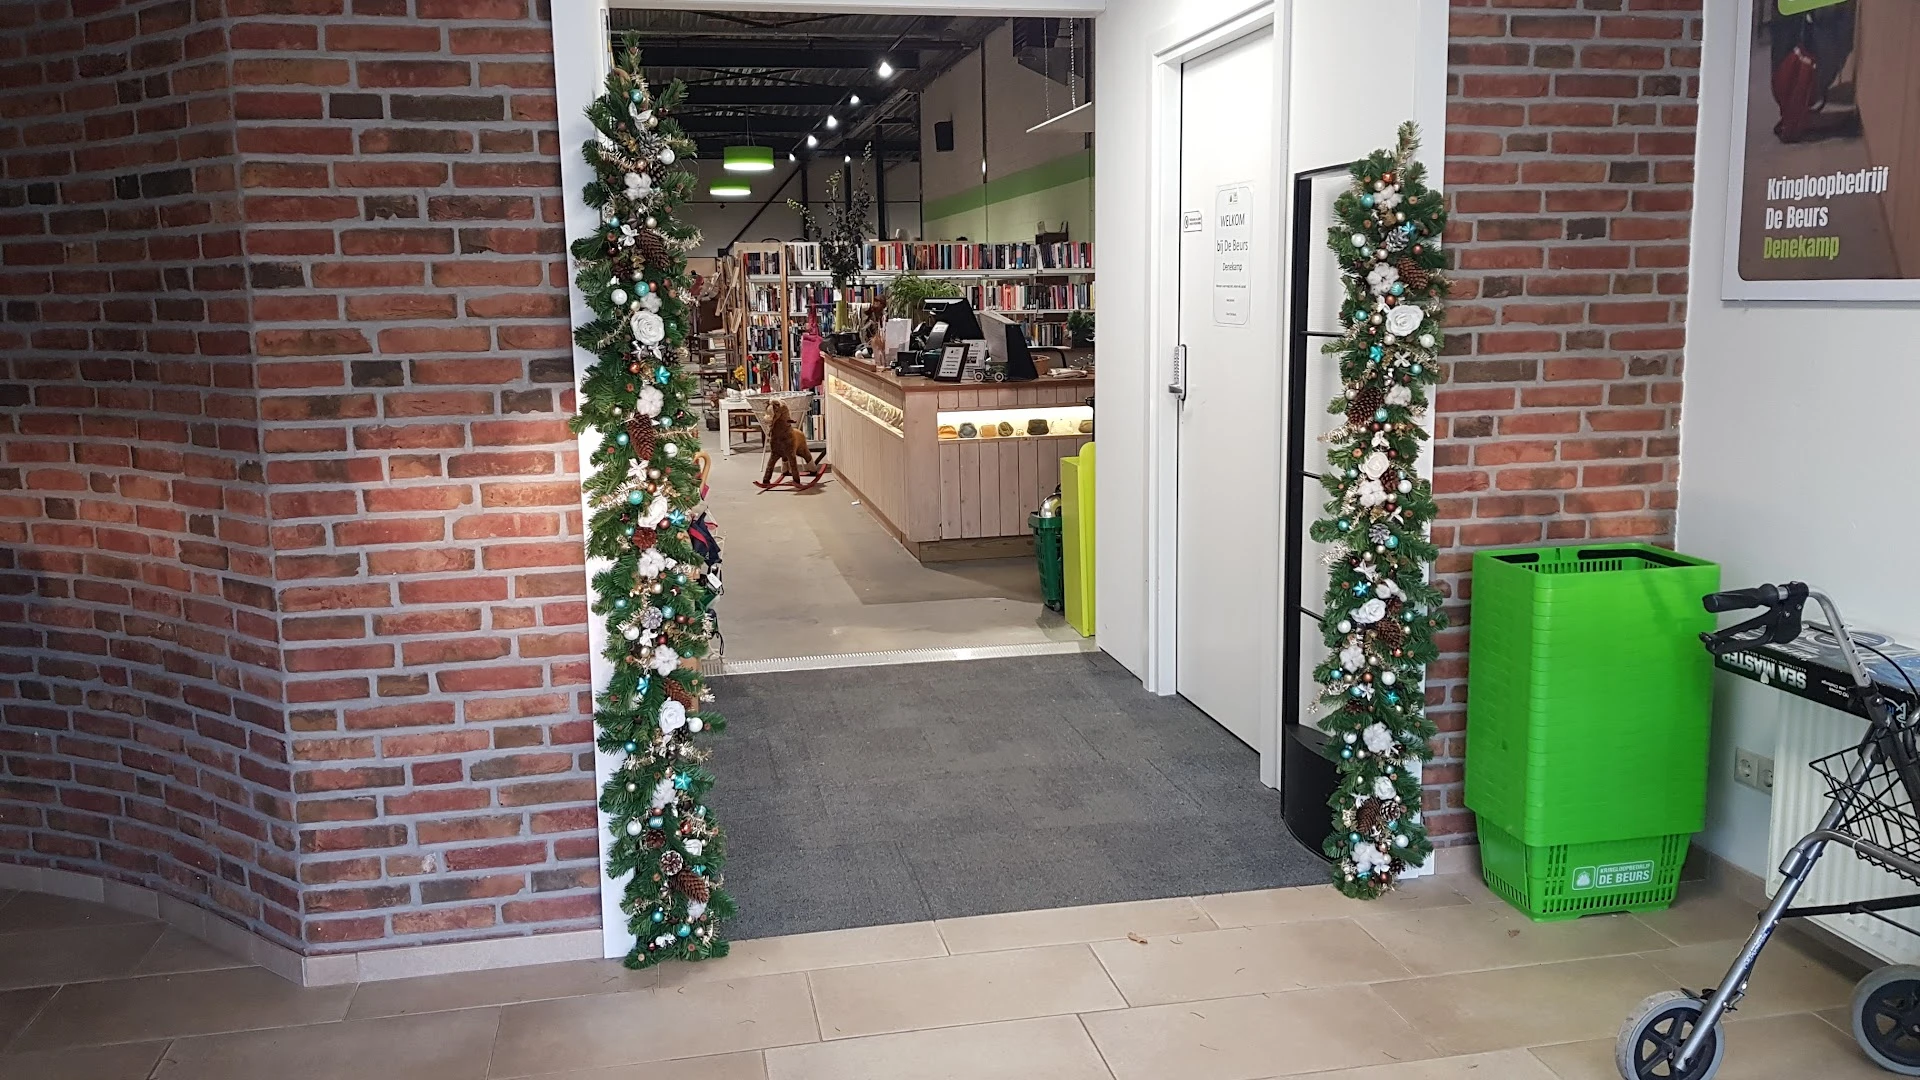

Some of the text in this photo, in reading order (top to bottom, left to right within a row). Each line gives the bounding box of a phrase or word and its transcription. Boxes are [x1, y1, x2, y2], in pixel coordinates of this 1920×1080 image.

[1767, 166, 1889, 200] Kringloopbedrijf
[1220, 213, 1245, 227] WELKOM
[1765, 205, 1829, 230] De Beurs
[1216, 239, 1249, 254] bij De Beurs
[1763, 234, 1840, 260] Denekamp
[1222, 261, 1243, 272] Denekamp
[1779, 665, 1807, 690] SEA
[1598, 870, 1650, 885] DE BEURS
